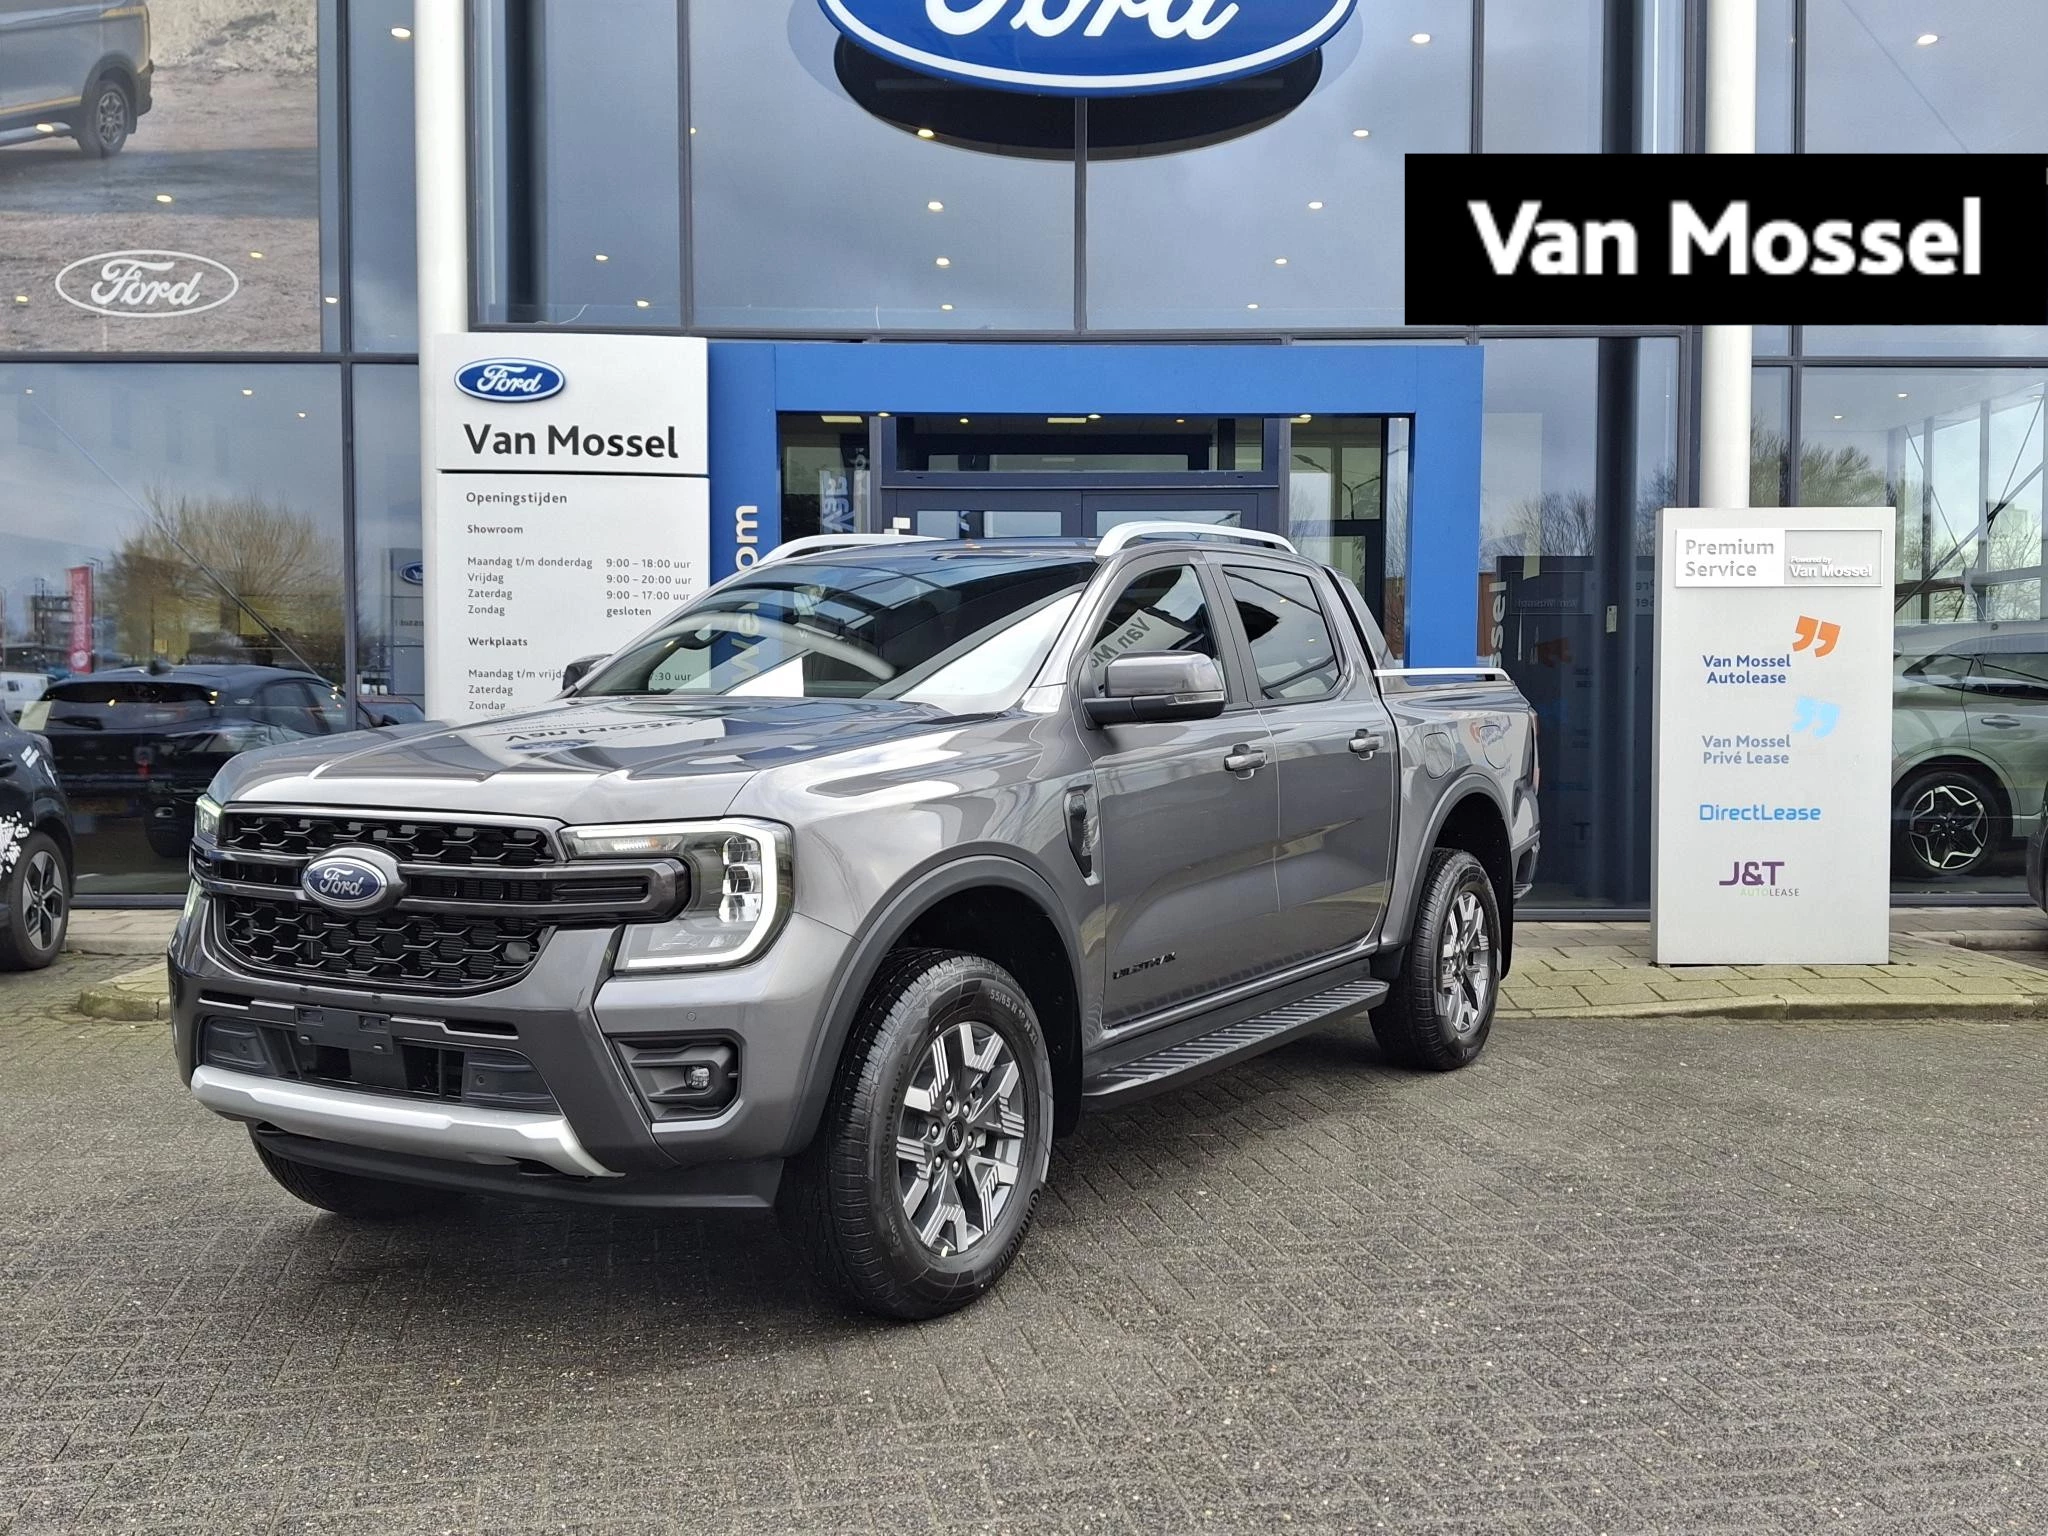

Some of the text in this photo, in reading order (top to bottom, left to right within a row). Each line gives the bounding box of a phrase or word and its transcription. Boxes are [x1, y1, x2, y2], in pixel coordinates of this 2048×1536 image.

[91, 259, 203, 306] Ford
[477, 364, 543, 392] Ford
[464, 424, 679, 458] Van Mossel
[466, 492, 567, 506] Openingstijden
[467, 524, 523, 534] Showroom
[1685, 539, 1774, 555] Premium
[467, 557, 513, 569] Maandag
[516, 557, 535, 567] t/m
[537, 557, 593, 570] donderdag
[606, 558, 630, 568] 9:00
[641, 559, 671, 569] 18:00
[673, 561, 692, 569] uur
[1790, 556, 1833, 565] Powered by
[1685, 561, 1757, 577] Service
[1790, 563, 1873, 577] Van Mossel
[467, 573, 505, 585] Vrijdag
[606, 574, 630, 584] 9:00
[641, 575, 672, 585] 20:00
[675, 577, 692, 585] uur
[467, 589, 513, 601] Zaterdag
[606, 590, 630, 600] 9:00
[641, 591, 670, 601] 17:00
[673, 593, 690, 601] uur
[467, 605, 652, 618] Zondag gesloten
[468, 637, 528, 649] Werkplaats
[1702, 653, 1792, 668] Van Mossel
[468, 669, 514, 681] Maandag
[517, 669, 536, 679] t/m
[539, 669, 565, 681] vrijd
[674, 672, 692, 681] uur
[1707, 670, 1787, 684] Autolease
[468, 685, 514, 697] Zaterdag
[1702, 734, 1792, 748] Van Mossel
[1703, 750, 1790, 765] Privé Lease
[1700, 804, 1822, 821] DirectLease
[1719, 861, 1785, 886] J&T
[319, 867, 364, 895] Ford
